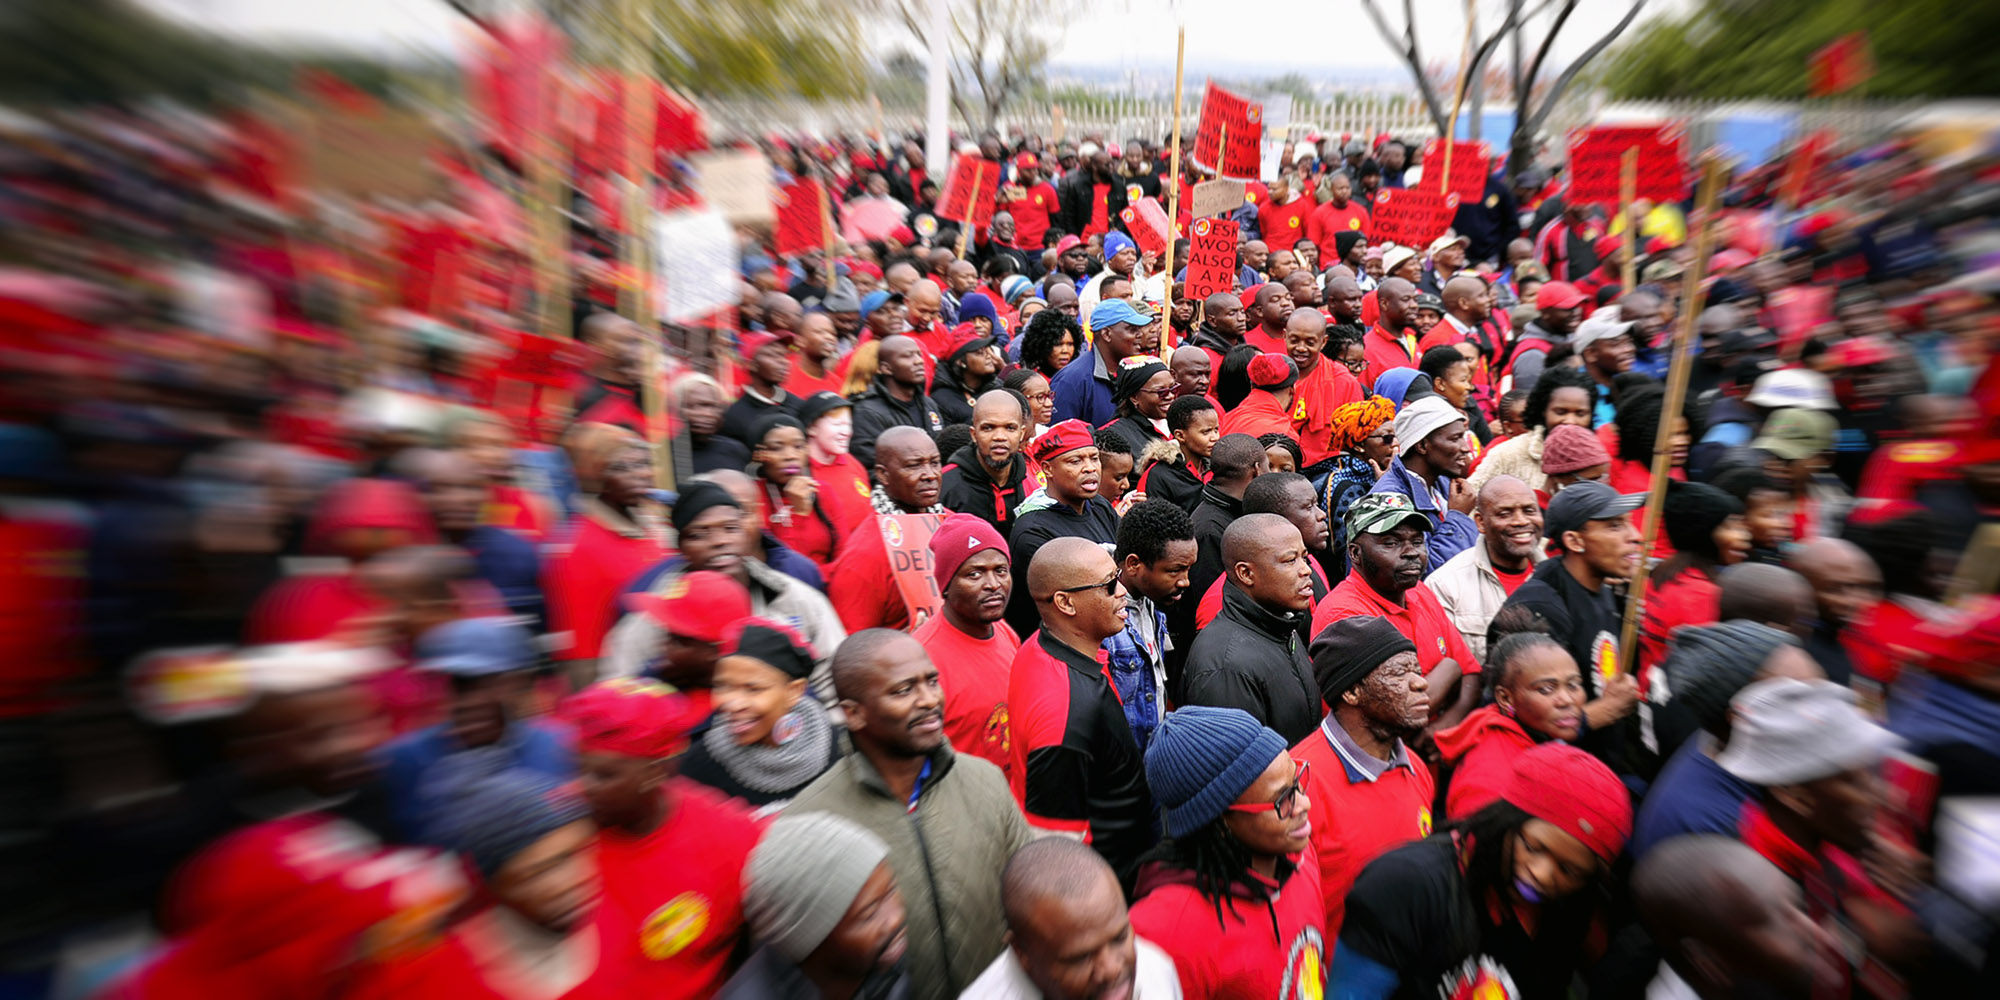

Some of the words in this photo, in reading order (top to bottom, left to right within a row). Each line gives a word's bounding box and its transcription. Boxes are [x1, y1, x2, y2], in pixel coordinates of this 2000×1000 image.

[1233, 133, 1257, 148] NOT
[1375, 207, 1431, 220] CANNOT
[1373, 221, 1400, 233] FOR
[1190, 252, 1234, 269] ALSO
[1200, 270, 1212, 282] A
[1192, 284, 1213, 298] TO
